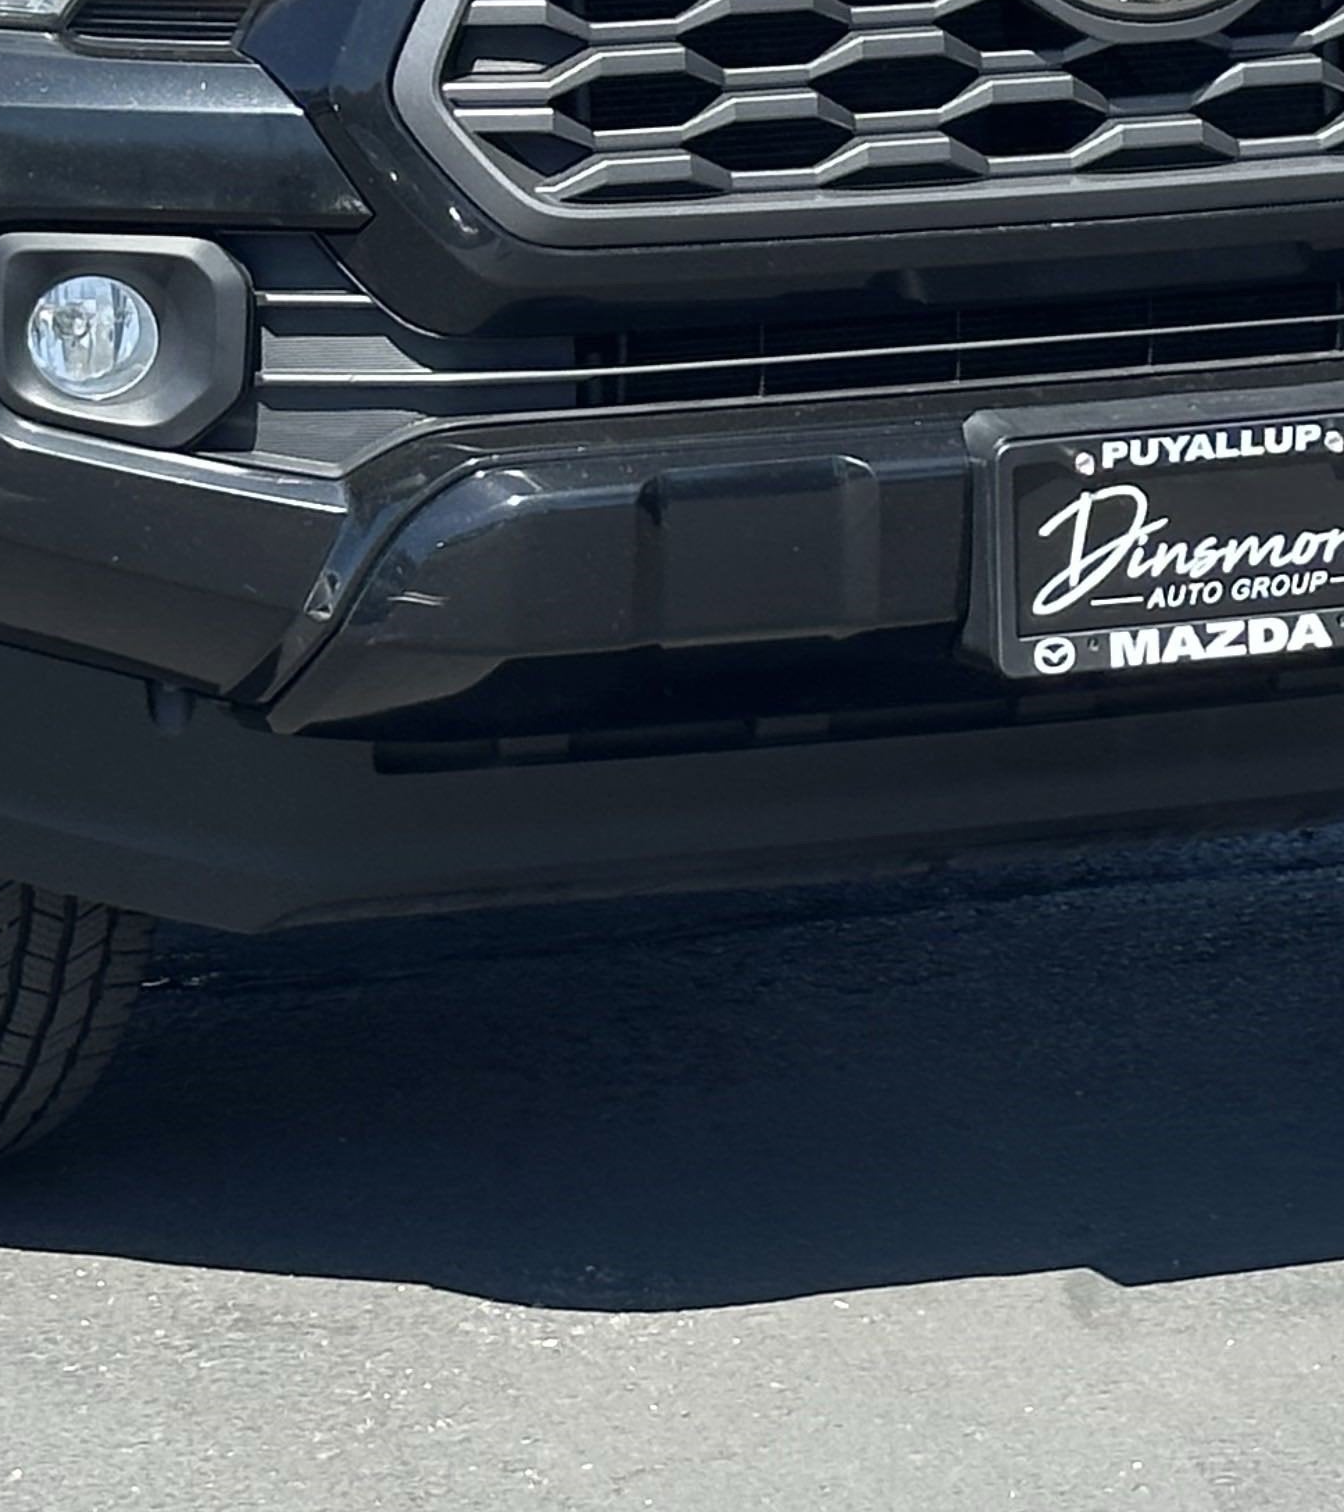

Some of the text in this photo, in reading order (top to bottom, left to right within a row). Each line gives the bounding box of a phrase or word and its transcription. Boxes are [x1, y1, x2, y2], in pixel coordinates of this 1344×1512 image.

[1102, 424, 1322, 469] PUYALLUP
[1147, 571, 1328, 610] AUTO GROUP
[1110, 612, 1332, 669] MAZDA
